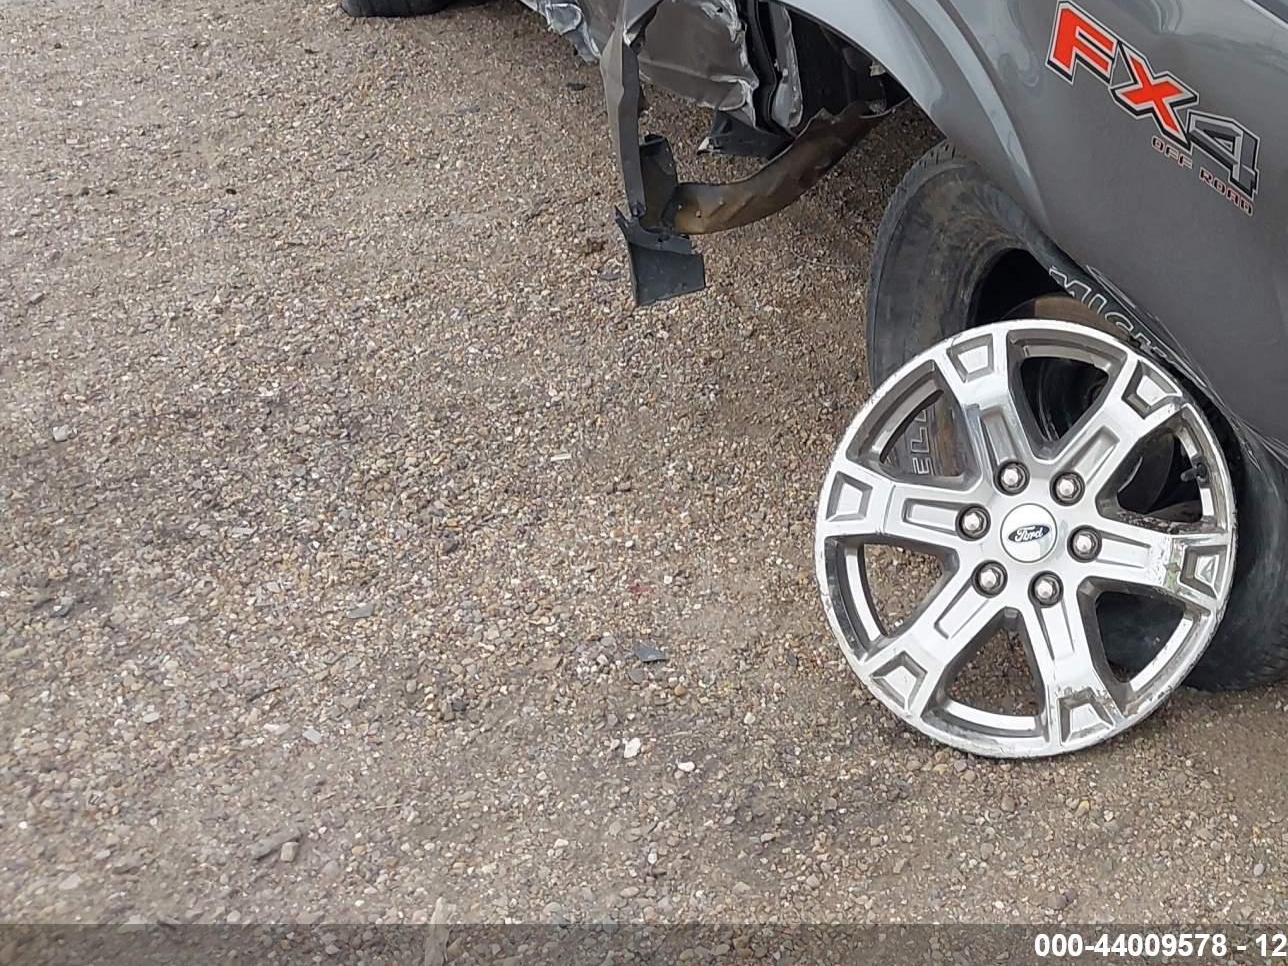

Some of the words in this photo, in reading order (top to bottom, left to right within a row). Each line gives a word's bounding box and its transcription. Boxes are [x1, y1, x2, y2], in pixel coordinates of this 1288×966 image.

[1152, 135, 1193, 169] OFF
[1199, 167, 1253, 217] ROAD
[1014, 525, 1045, 542] Ford
